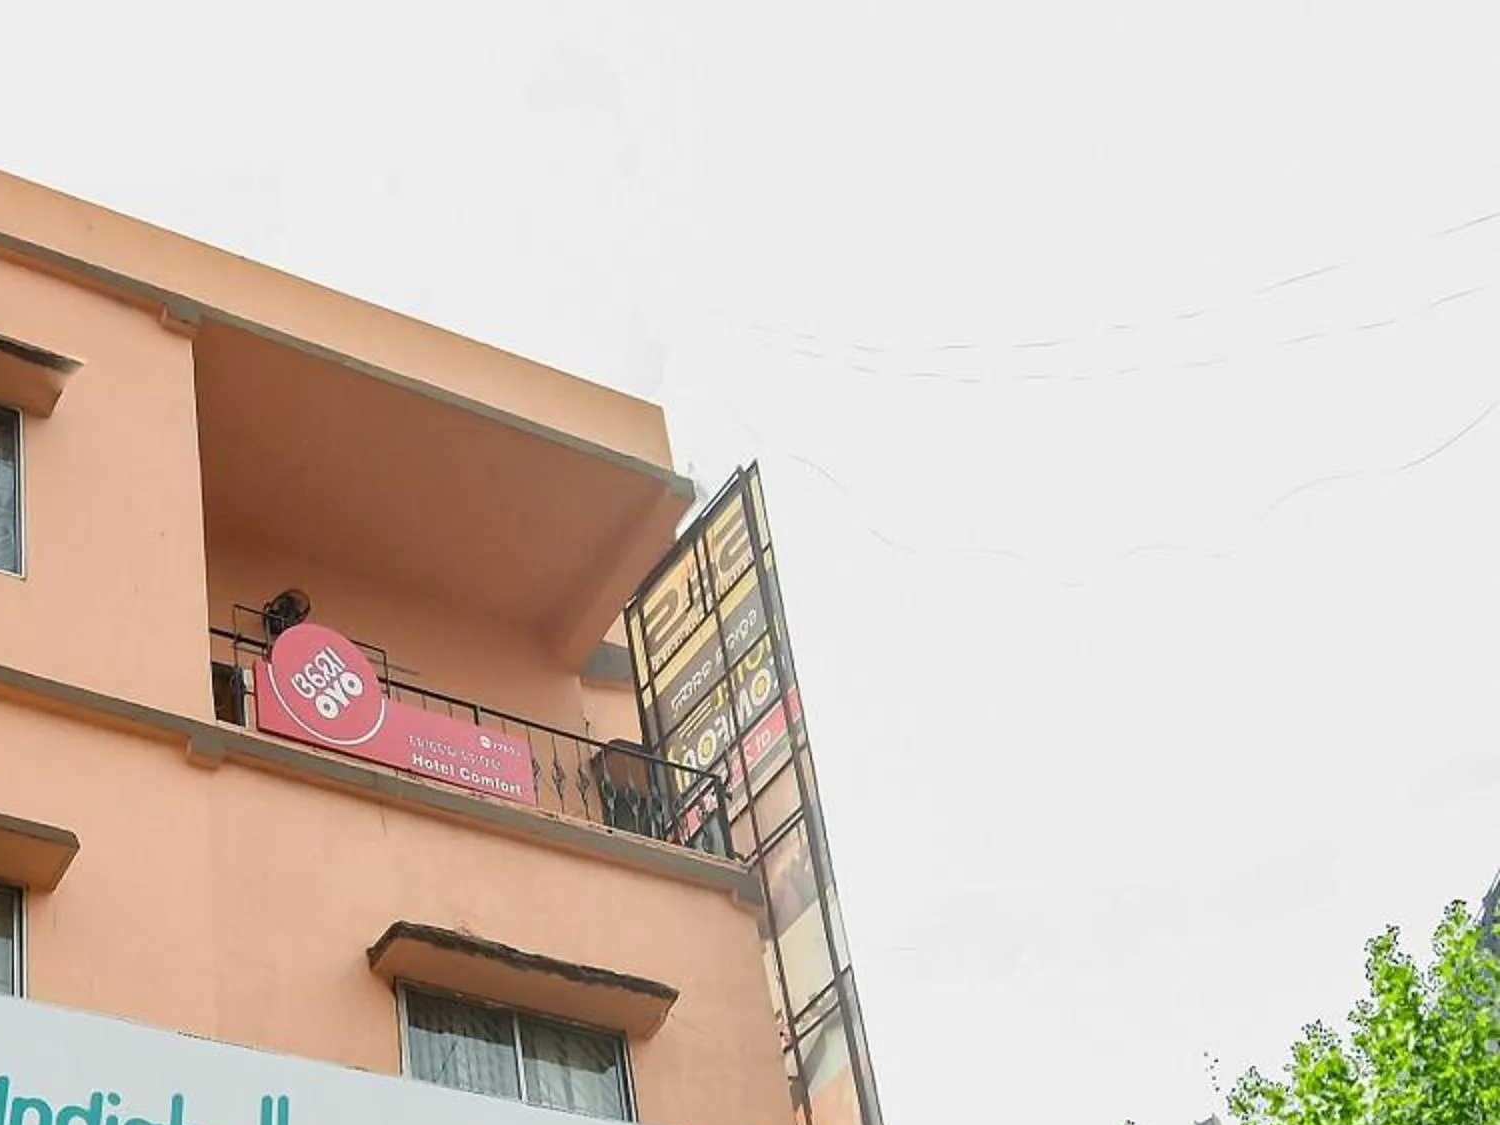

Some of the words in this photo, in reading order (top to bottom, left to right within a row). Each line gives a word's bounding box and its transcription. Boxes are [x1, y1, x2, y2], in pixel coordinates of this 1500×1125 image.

[315, 672, 364, 719] OYO
[412, 752, 457, 777] Hotel
[460, 766, 522, 797] Comfort
